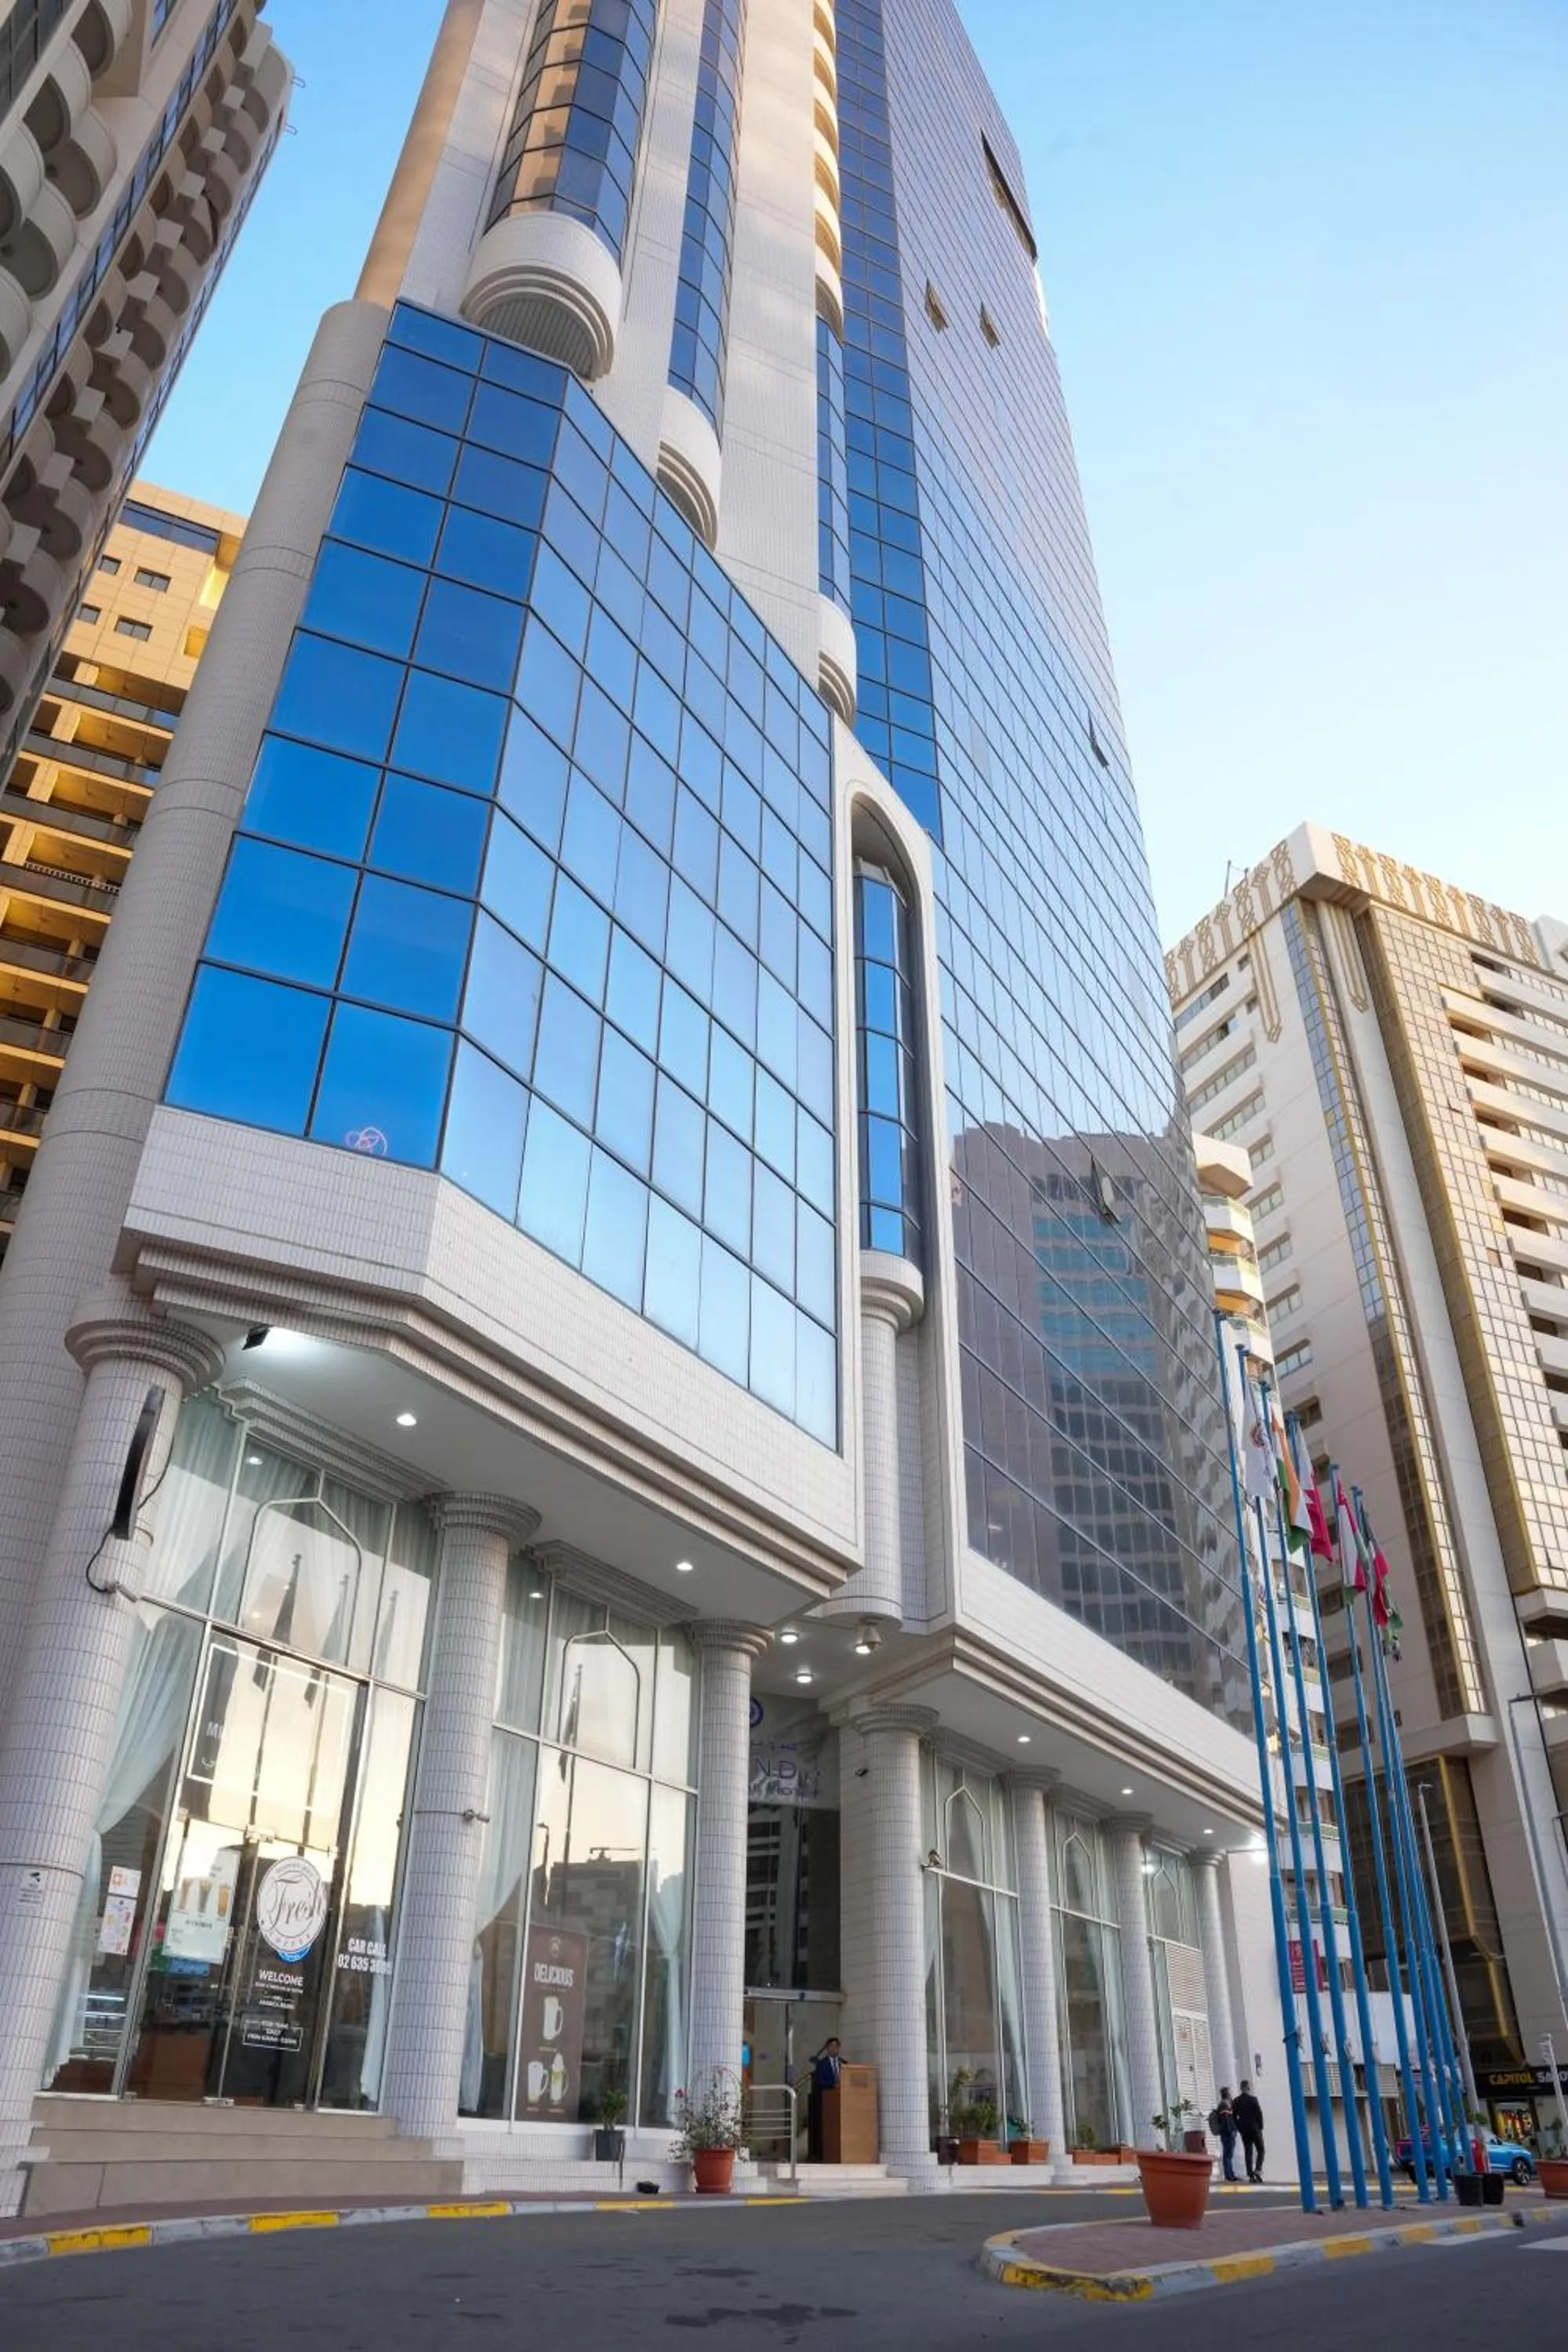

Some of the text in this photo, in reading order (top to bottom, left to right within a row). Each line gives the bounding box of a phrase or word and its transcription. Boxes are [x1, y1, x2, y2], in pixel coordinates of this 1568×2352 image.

[347, 1937, 366, 1954] CAR
[338, 1953, 350, 1969] 02
[260, 1969, 303, 1987] WELCOME
[534, 1963, 574, 1987] DELICIOUS
[1490, 2072, 1535, 2085] CAPITOL
